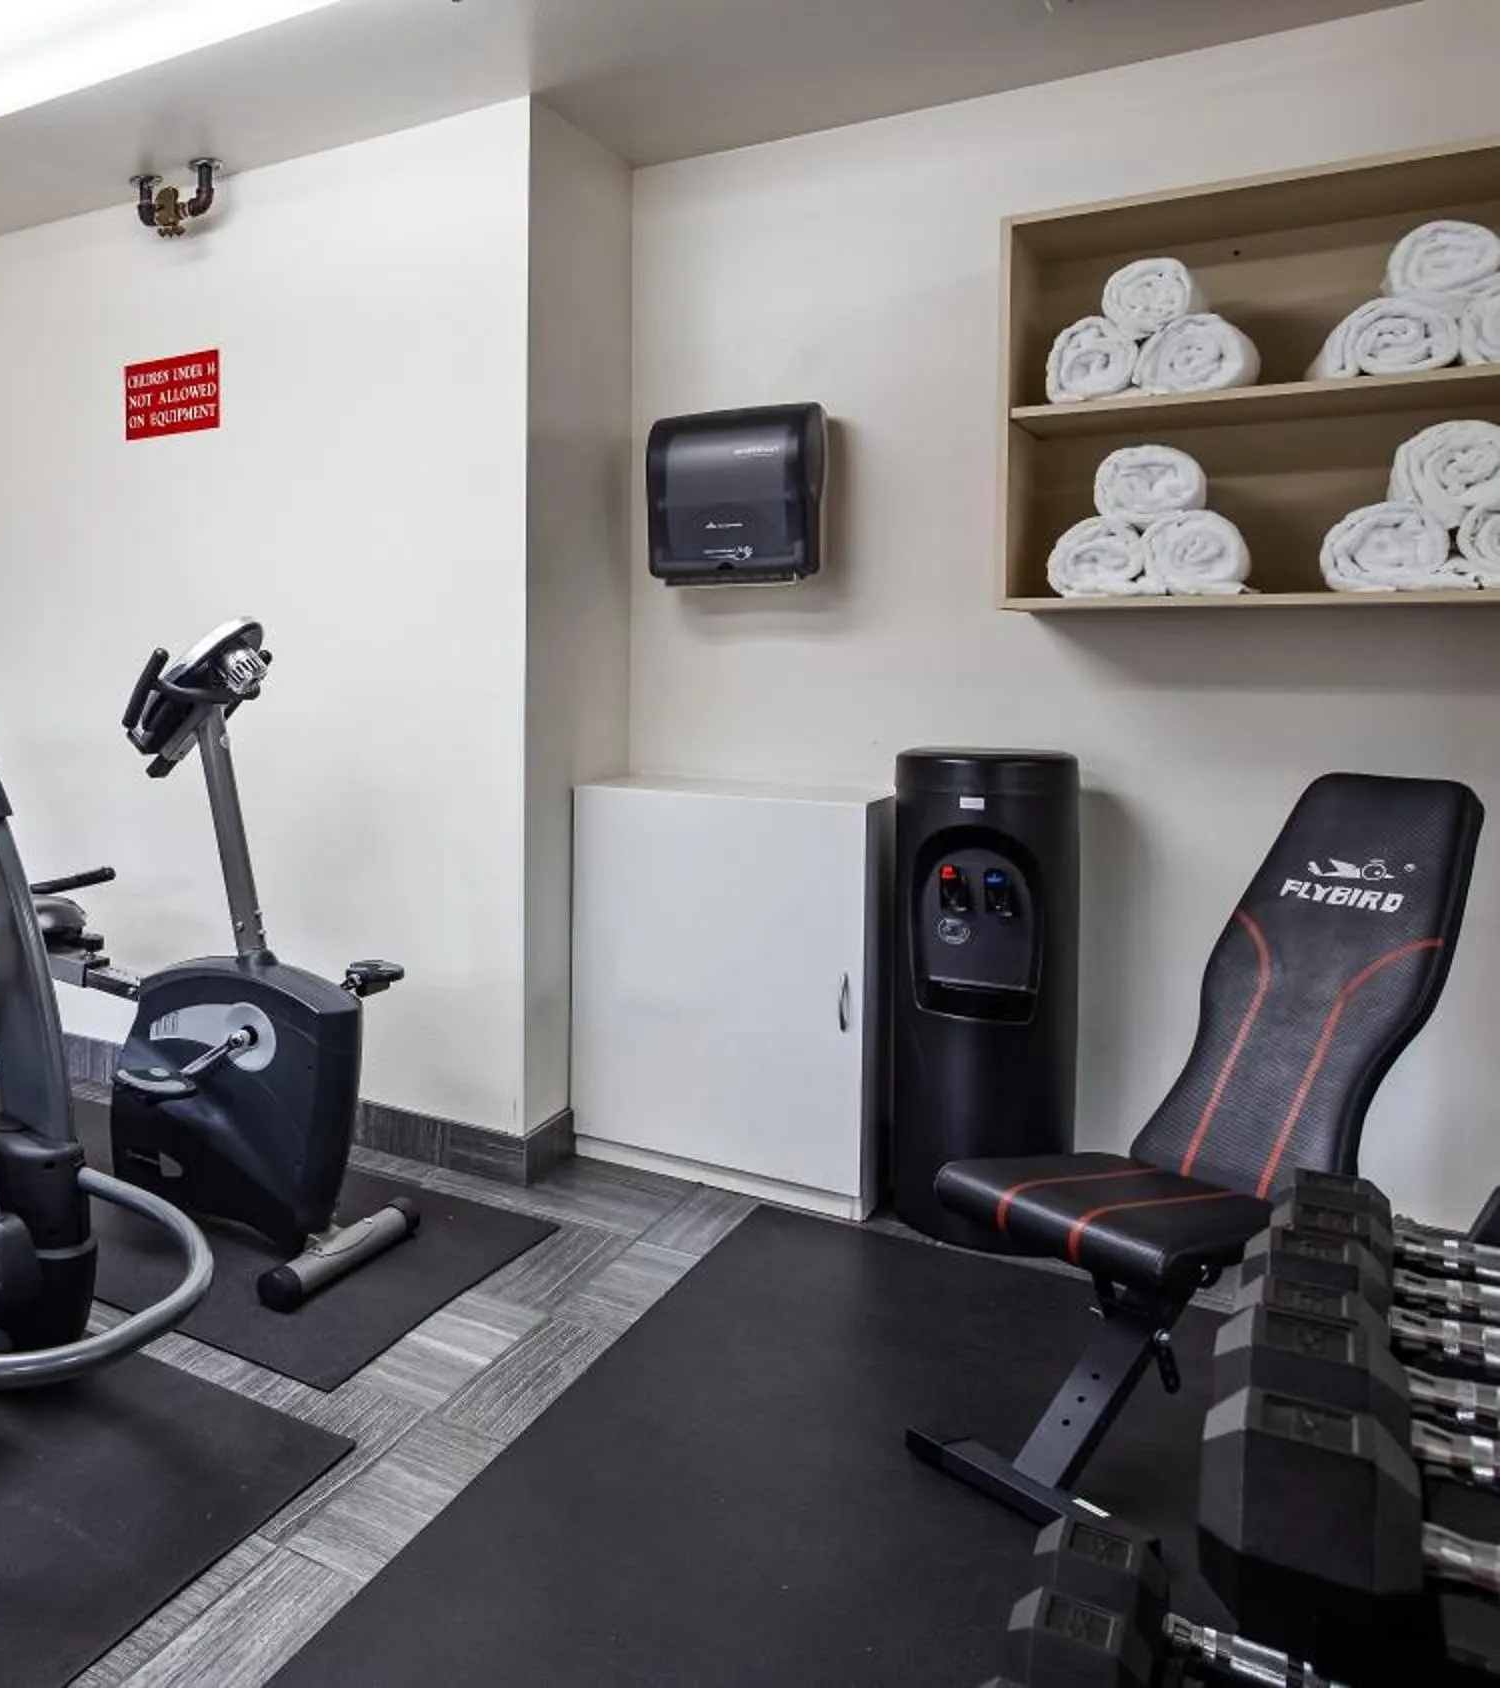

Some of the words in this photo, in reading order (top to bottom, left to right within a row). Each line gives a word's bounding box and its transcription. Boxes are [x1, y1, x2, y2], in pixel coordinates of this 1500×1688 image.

[129, 393, 152, 409] NOT
[158, 382, 216, 404] ALLOWED
[129, 414, 145, 428] ON
[150, 404, 216, 426] EQUIPMENT
[1279, 877, 1405, 914] FLYBIRD
